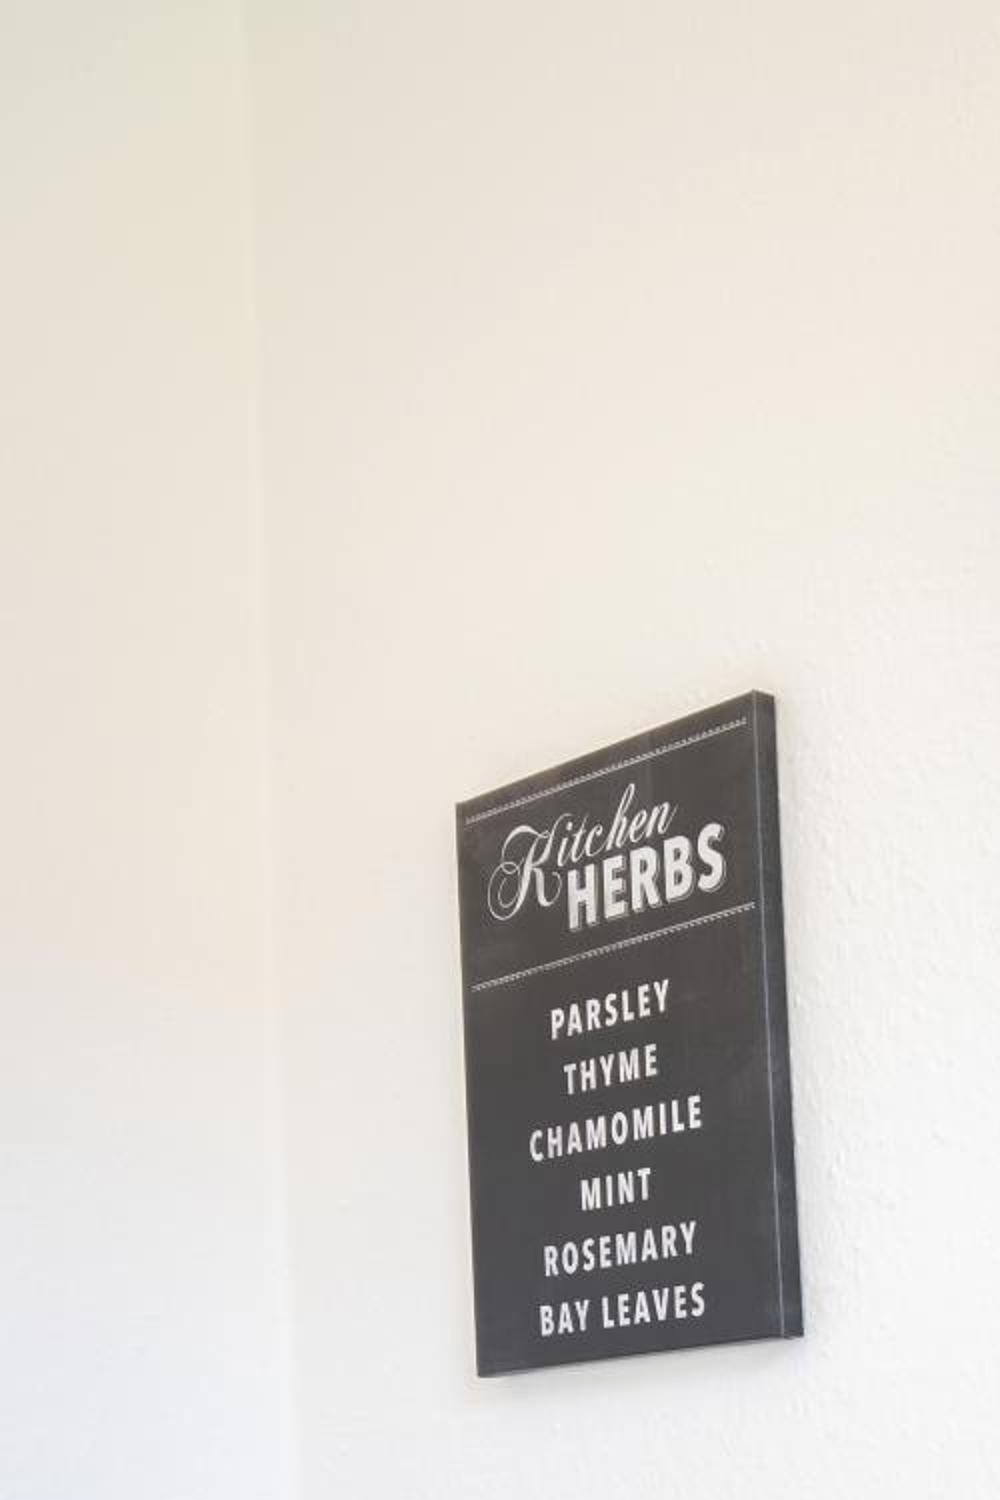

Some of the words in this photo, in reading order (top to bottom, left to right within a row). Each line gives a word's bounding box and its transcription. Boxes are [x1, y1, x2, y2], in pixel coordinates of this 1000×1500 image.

[487, 782, 679, 921] Kitchen
[566, 822, 727, 932] HERBS
[550, 978, 670, 1041] PARSLEY
[563, 1042, 659, 1095] THYME
[528, 1094, 703, 1162] CHAMOMILE
[580, 1167, 651, 1211] MINT
[543, 1221, 697, 1277] ROSEMARY
[539, 1299, 590, 1337] BAY
[601, 1281, 706, 1330] LEAVES
